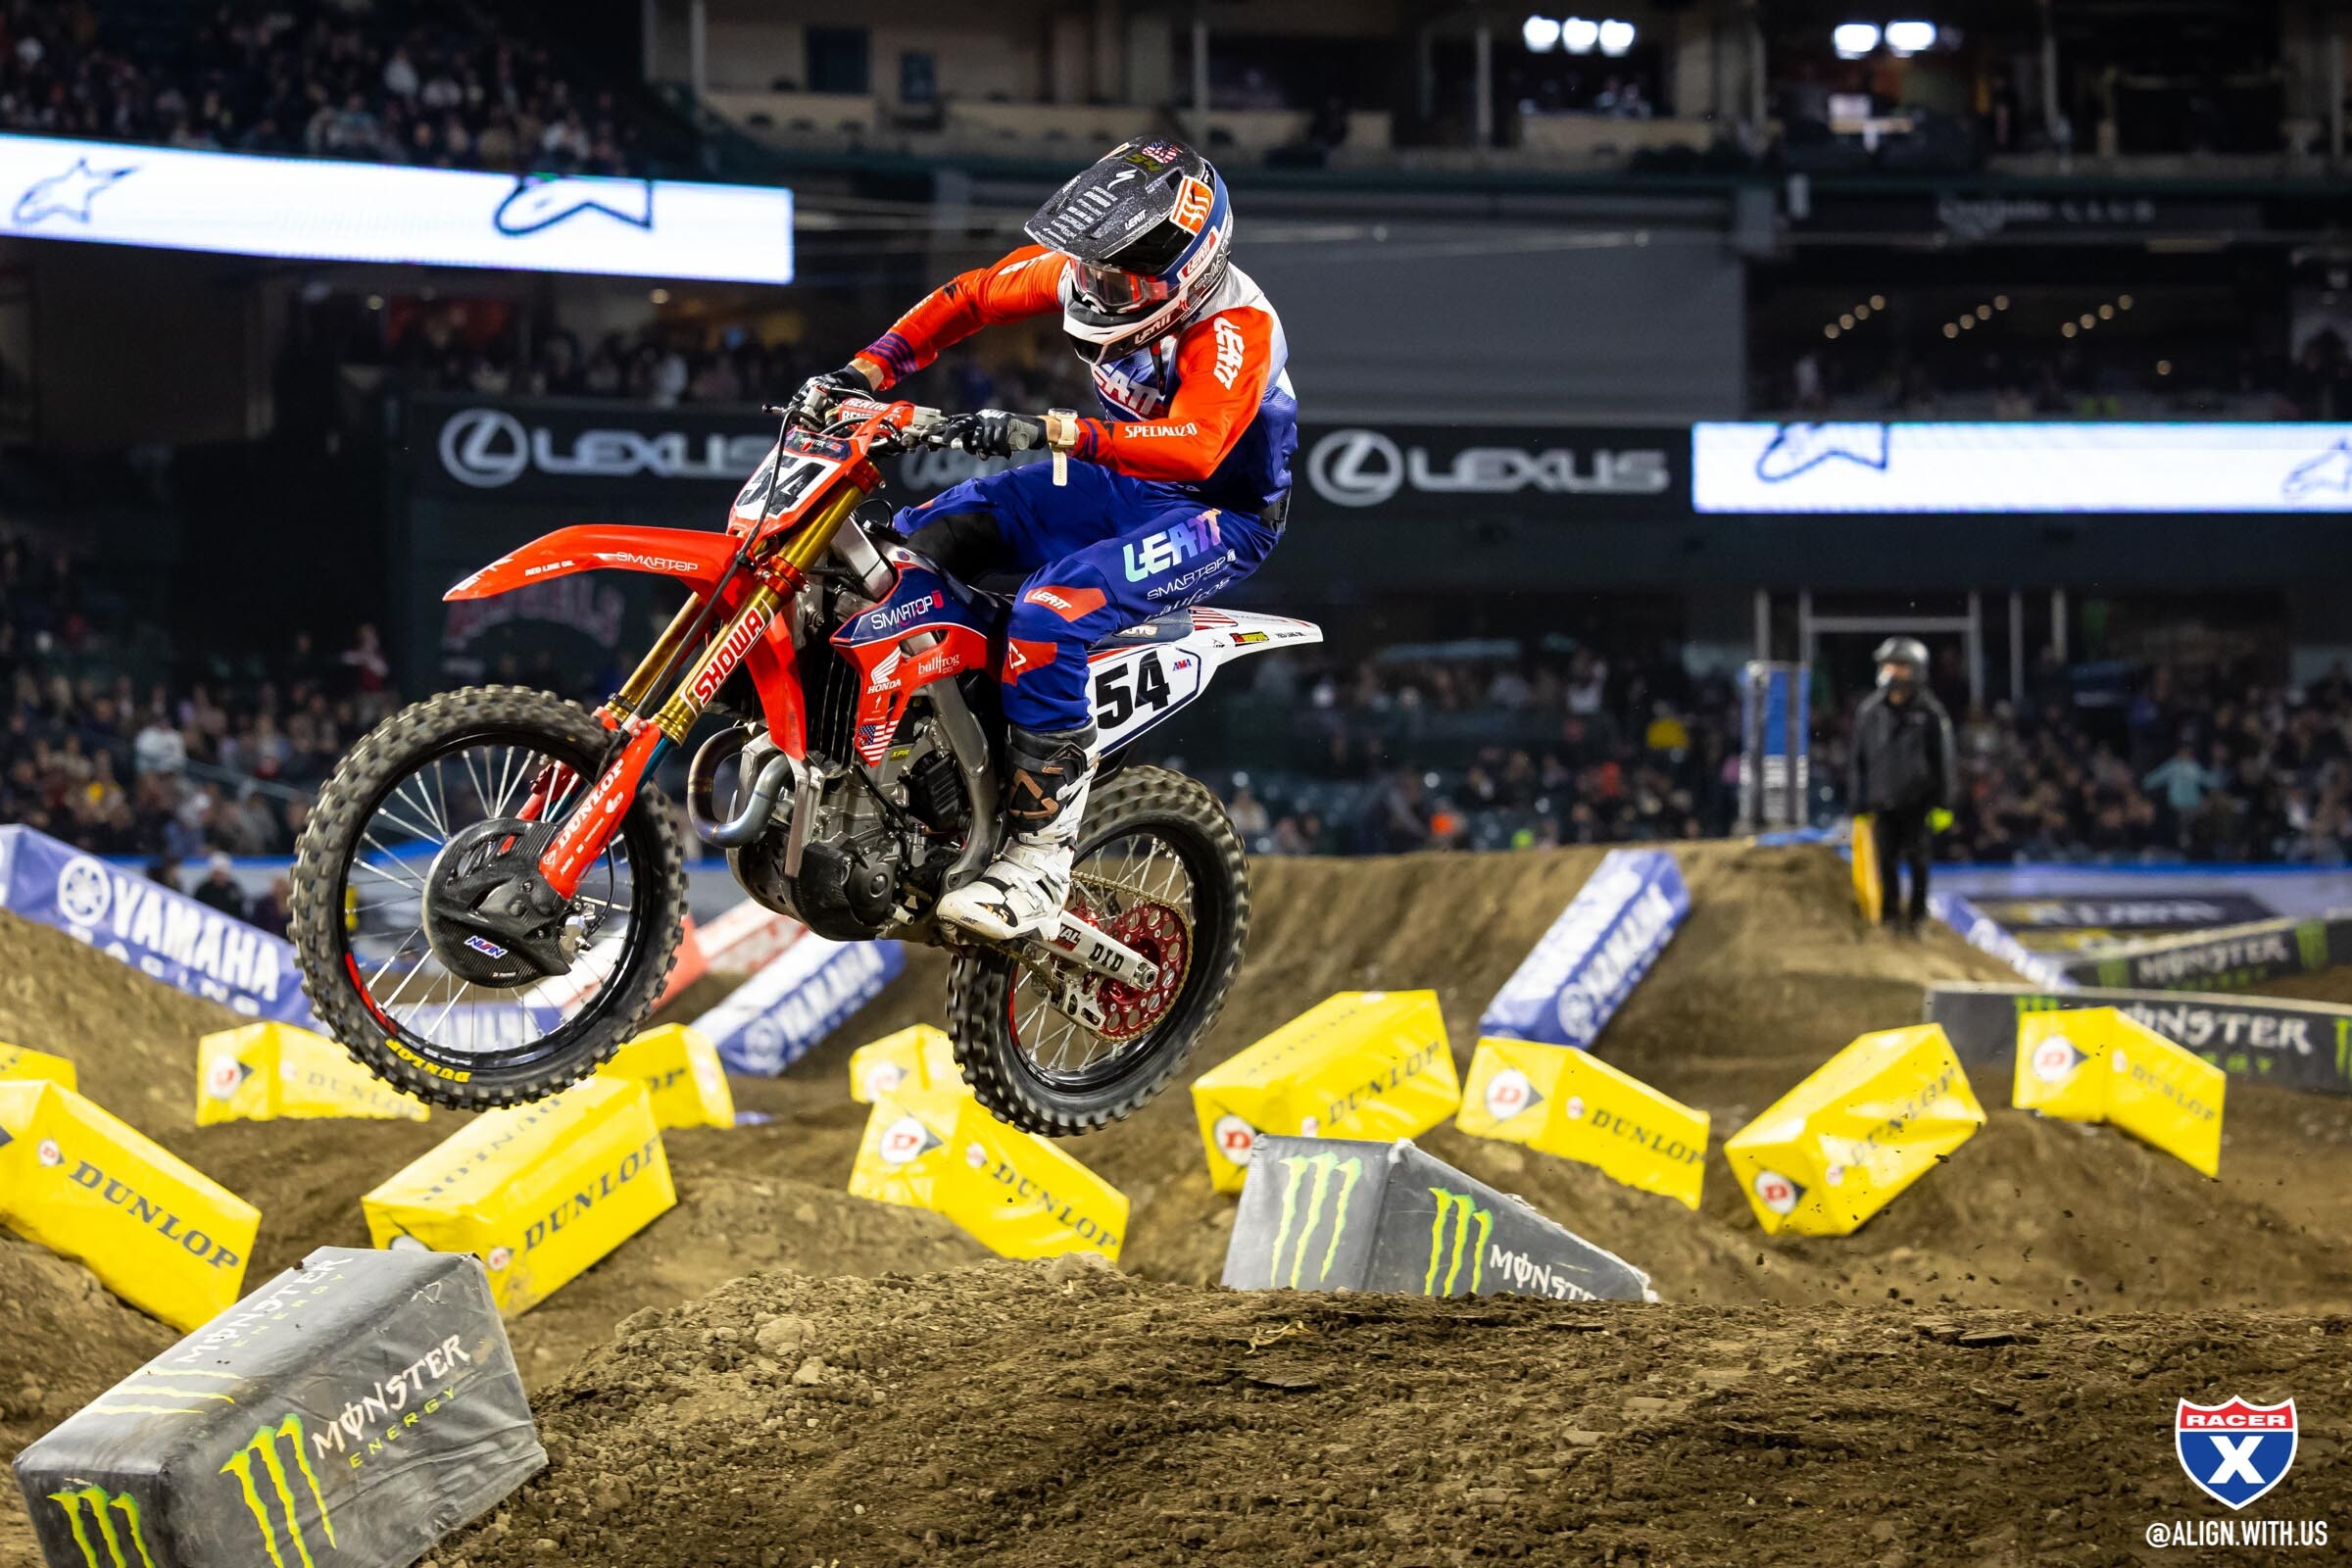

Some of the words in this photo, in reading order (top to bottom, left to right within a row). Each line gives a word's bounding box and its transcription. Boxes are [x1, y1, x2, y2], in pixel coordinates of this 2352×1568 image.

[1124, 209, 1147, 230] LEATT
[1187, 241, 1212, 274] LEATT
[1134, 312, 1175, 345] LEATT
[1212, 317, 1246, 391] LEATT
[1407, 446, 1670, 493] LEXUS
[524, 565, 542, 576] RED
[542, 562, 562, 573] LINE
[561, 560, 576, 568] OIL
[615, 551, 699, 572] SMARTOP
[1122, 508, 1223, 584] LEATT
[1030, 589, 1073, 611] LEATT
[1147, 556, 1226, 601] SMARTOP
[870, 595, 934, 630] SMARTOP
[693, 607, 764, 707] SHOWA
[916, 650, 960, 676] bullfrog
[1172, 658, 1193, 672] AMA
[866, 678, 902, 695] HONDA
[1094, 649, 1172, 730] 54
[557, 759, 625, 851] DUNLOP
[113, 875, 282, 1002] YAMAHA
[2122, 1001, 2315, 1055] ONSTER
[384, 1038, 472, 1084] DUNLOP
[1328, 1040, 1441, 1126] DUNLOP
[2132, 1063, 2217, 1121] DUNLOP
[68, 1159, 240, 1270] DUNLOP
[991, 1160, 1118, 1250] DUNLOP
[231, 1274, 346, 1349] ENERGY
[349, 1386, 456, 1470] ENERGY
